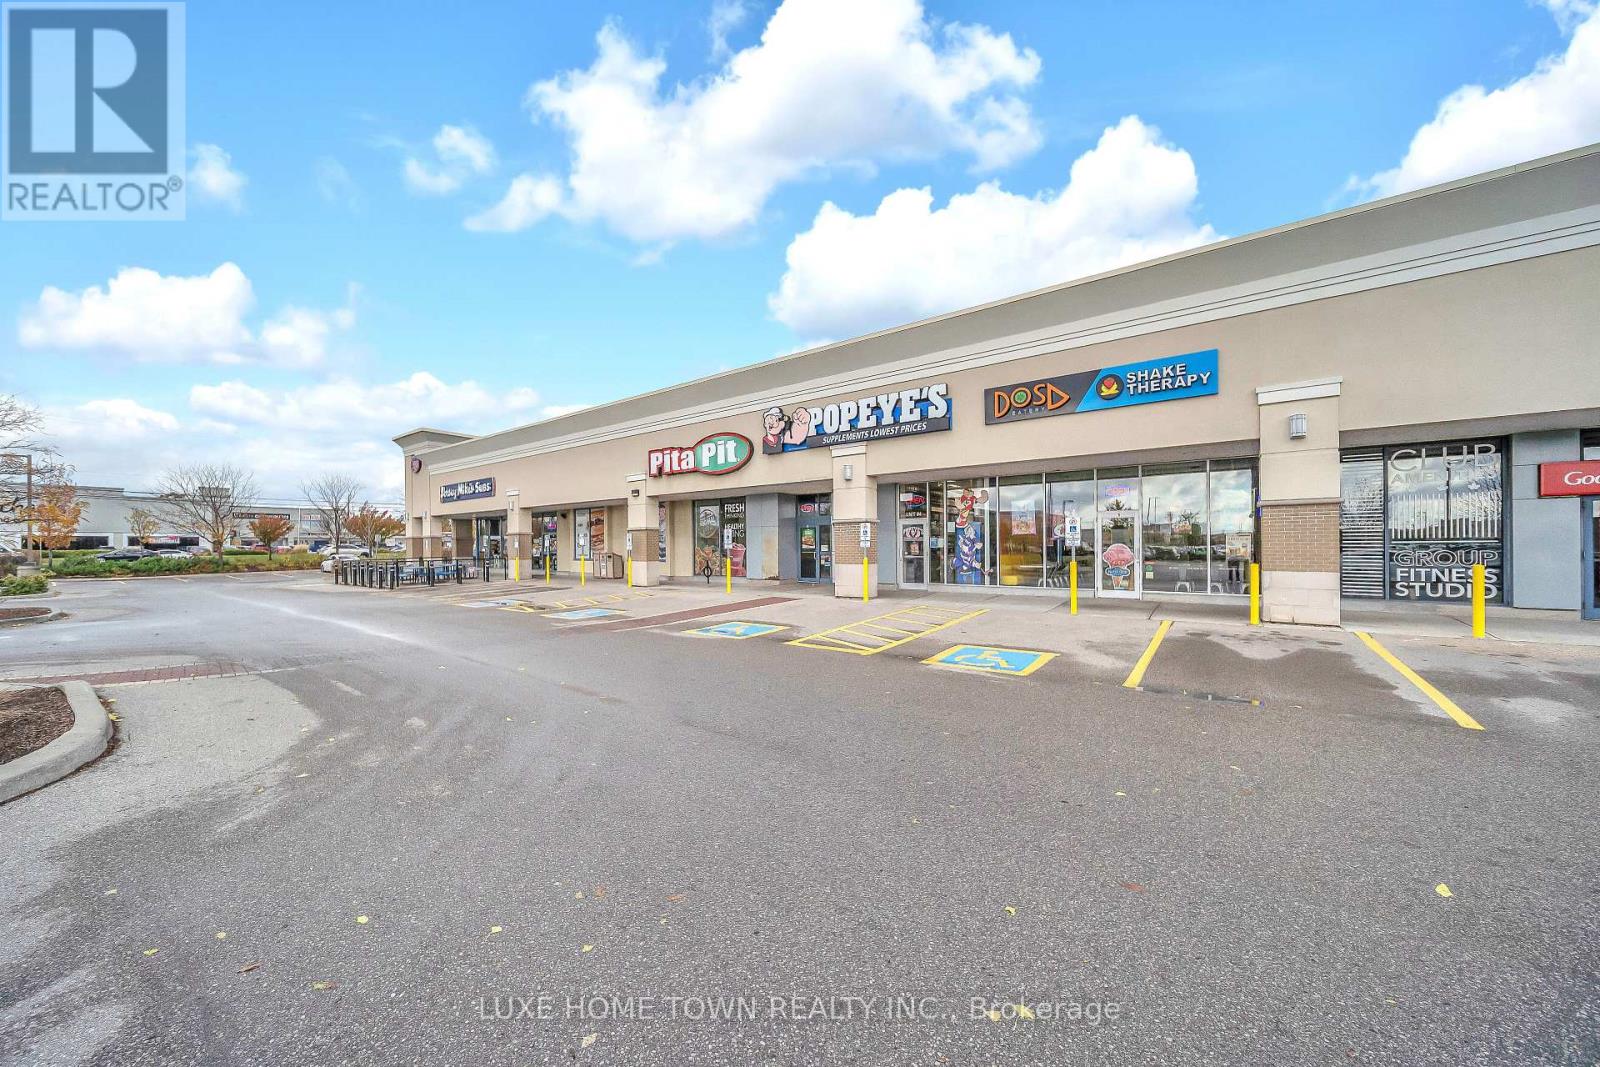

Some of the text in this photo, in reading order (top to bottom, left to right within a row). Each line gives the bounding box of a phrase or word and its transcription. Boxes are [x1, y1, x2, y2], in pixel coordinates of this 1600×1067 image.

[1126, 363, 1187, 384] SHAKE
[1126, 372, 1212, 396] THERAPY
[809, 382, 949, 436] POPEYE'S
[1012, 407, 1045, 416] EATERY
[822, 421, 928, 444] SUPPLEMENTS LOWEST PRICES
[650, 439, 738, 475] Pita Pit
[724, 503, 745, 514] FRESH
[1394, 550, 1499, 567] GROUP
